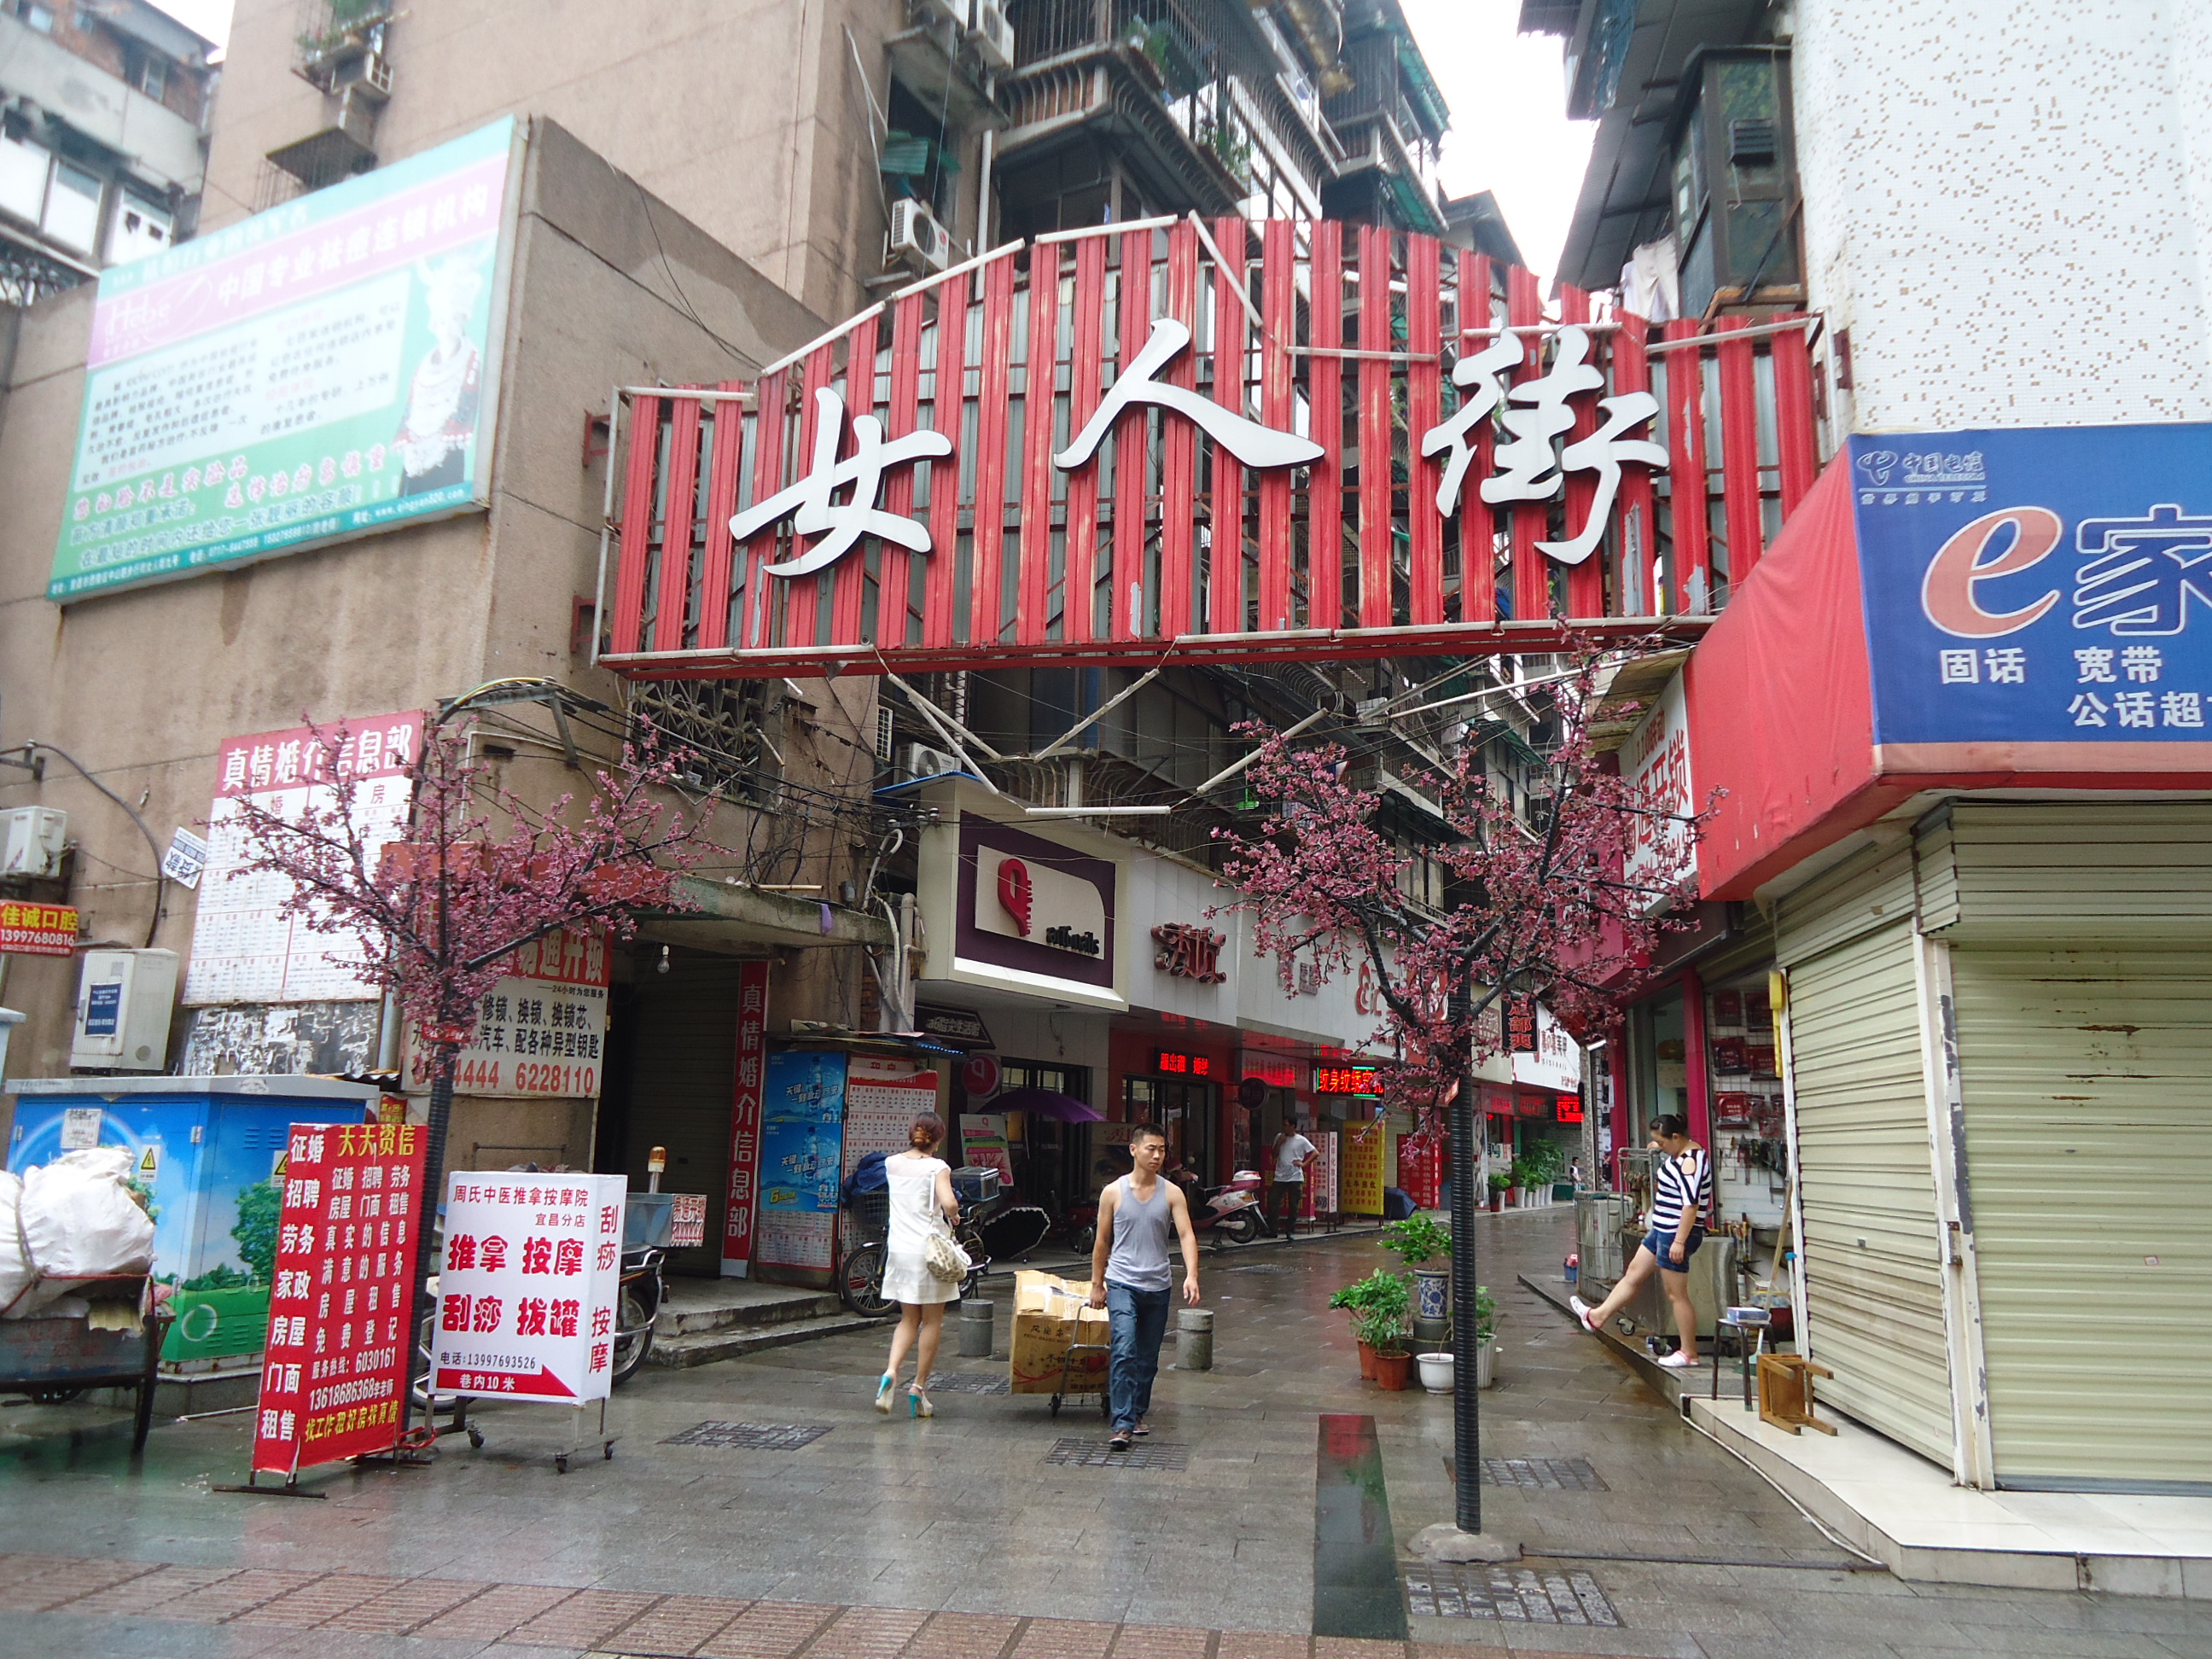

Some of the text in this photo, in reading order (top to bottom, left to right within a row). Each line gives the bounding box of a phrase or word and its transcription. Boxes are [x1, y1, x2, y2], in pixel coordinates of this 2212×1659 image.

[215, 178, 491, 311] 中国专业祛痘连锁机构
[728, 317, 1671, 579] 女人街
[1903, 451, 1983, 474] 中国电信
[72, 451, 250, 522] 您的脸不是实验品
[1939, 647, 2163, 684] 固话 宽带
[2, 905, 79, 930] 佳诚口腔
[1, 929, 75, 946] 13997680816
[515, 1062, 595, 1094] 6228110
[1160, 1051, 1186, 1074] 服出租
[728, 983, 764, 1239] 真情婚介信息部
[290, 1133, 325, 1164] 征婚
[338, 1124, 416, 1157] 天天资信
[332, 1164, 410, 1190] 征婚 招聘 劳务
[287, 1178, 320, 1209] 招聘
[328, 1194, 409, 1221] 房屋 门面 租售
[453, 1185, 589, 1208] 周氏中医推拿按摩院
[325, 1220, 406, 1251] 真实的信息
[535, 1213, 586, 1228] 宜昌分店
[282, 1223, 316, 1254] 劳务
[597, 1203, 619, 1272] 刮痧
[322, 1250, 405, 1286] 满意的服务
[447, 1233, 585, 1277] 推拿 按摩
[276, 1269, 311, 1300] 家政
[317, 1282, 402, 1318] 房屋租售
[271, 1316, 306, 1347] 房屋
[442, 1294, 580, 1338] 刮痧 拔罐
[315, 1316, 398, 1353] 免费登记
[588, 1306, 611, 1375] 按摩
[355, 1347, 396, 1371] 6030161
[266, 1362, 301, 1394] 门面
[261, 1408, 295, 1441] 租售
